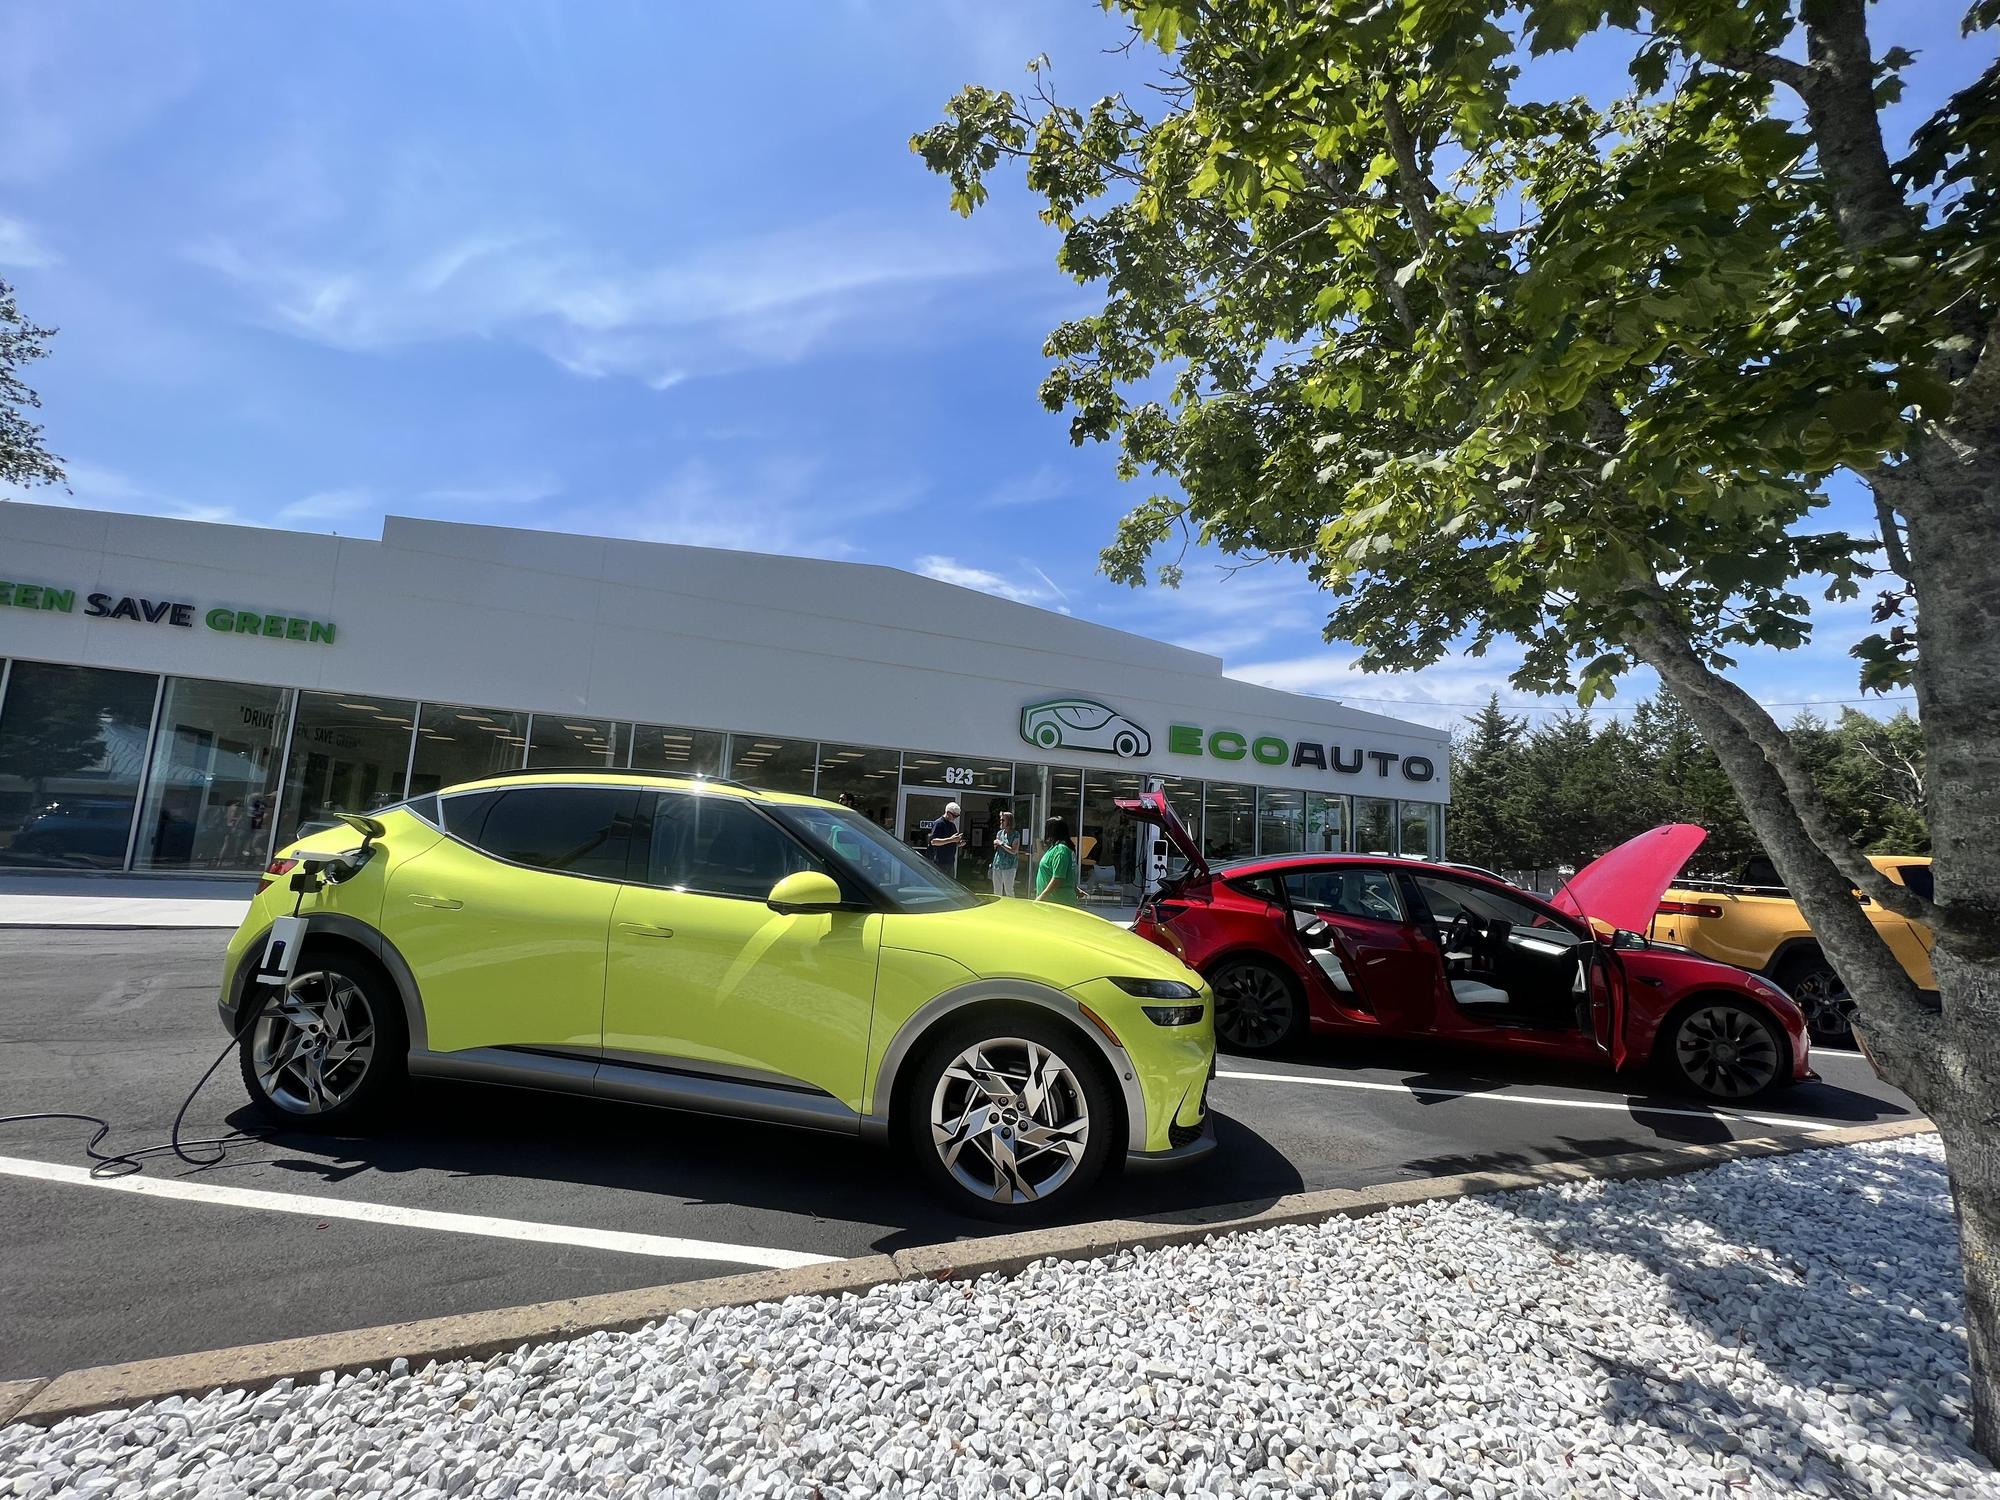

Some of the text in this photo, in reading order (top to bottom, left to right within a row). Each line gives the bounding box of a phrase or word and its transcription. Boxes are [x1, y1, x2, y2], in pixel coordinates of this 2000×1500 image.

[84, 593, 195, 628] SAVE
[205, 608, 337, 645] GREEN
[945, 766, 974, 785] 623
[1169, 725, 1435, 782] ECOAUTO
